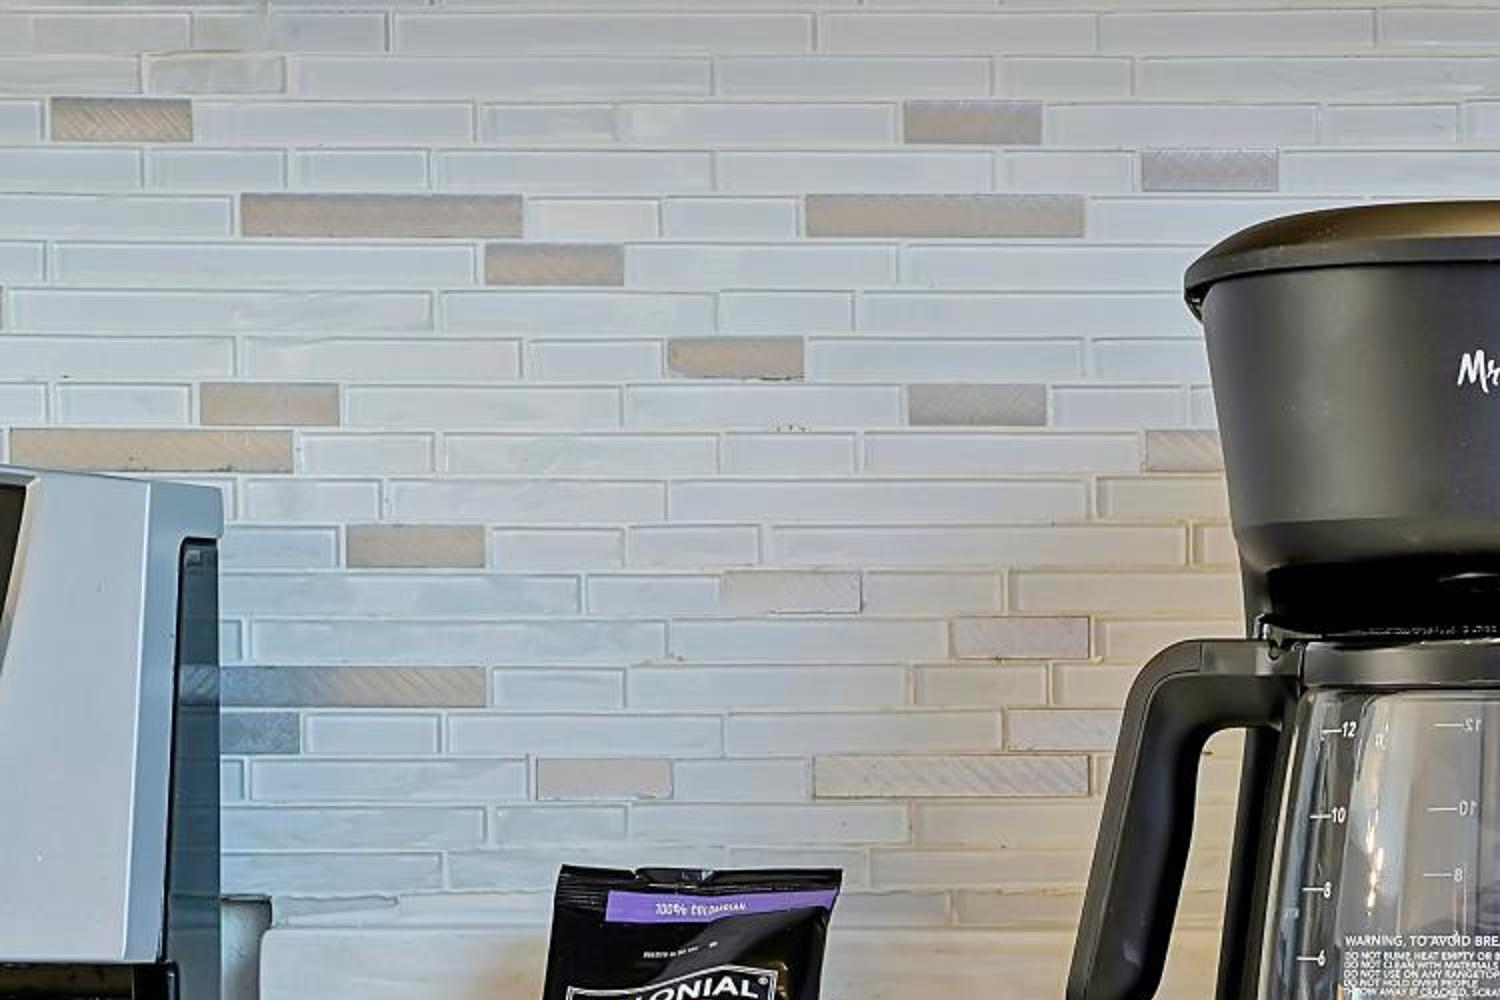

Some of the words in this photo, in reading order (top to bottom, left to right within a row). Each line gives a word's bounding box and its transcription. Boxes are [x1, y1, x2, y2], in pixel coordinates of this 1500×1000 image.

[1342, 721, 1357, 737] 12
[1332, 807, 1346, 823] 10
[1323, 881, 1332, 898] 8
[1410, 935, 1427, 947] TO
[1429, 935, 1471, 947] AVOID
[1318, 950, 1327, 966] 6
[1361, 952, 1381, 960] NOT
[1441, 952, 1475, 960] EMPTY
